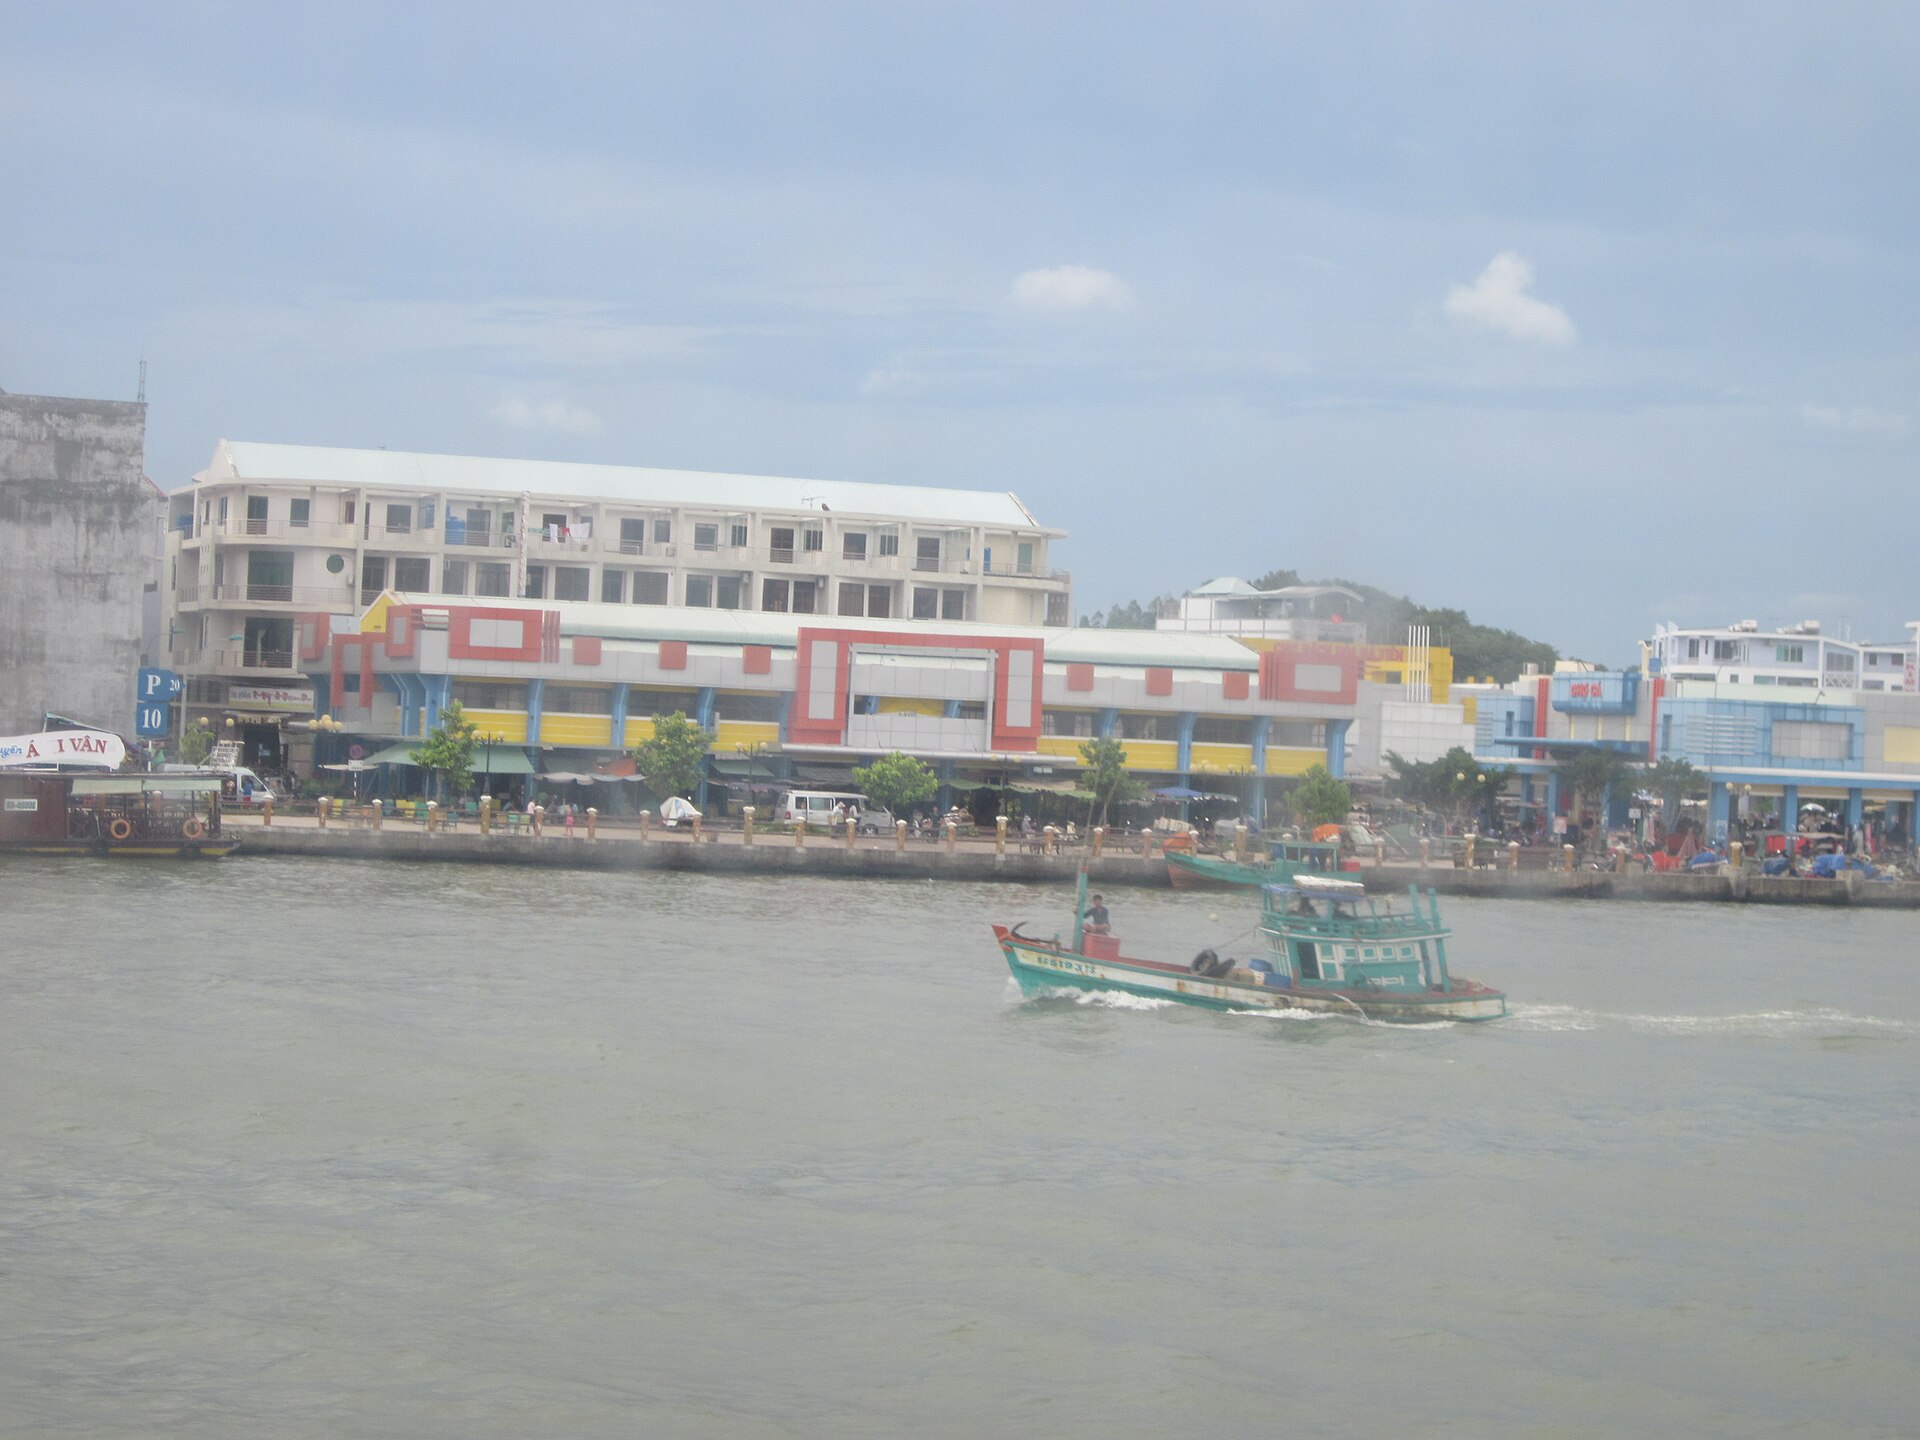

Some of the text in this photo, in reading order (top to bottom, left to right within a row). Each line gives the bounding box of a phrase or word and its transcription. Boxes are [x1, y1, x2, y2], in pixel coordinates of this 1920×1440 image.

[145, 674, 161, 695] P
[169, 679, 180, 691] 20
[142, 708, 162, 729] 10
[69, 734, 108, 754] VÂN
